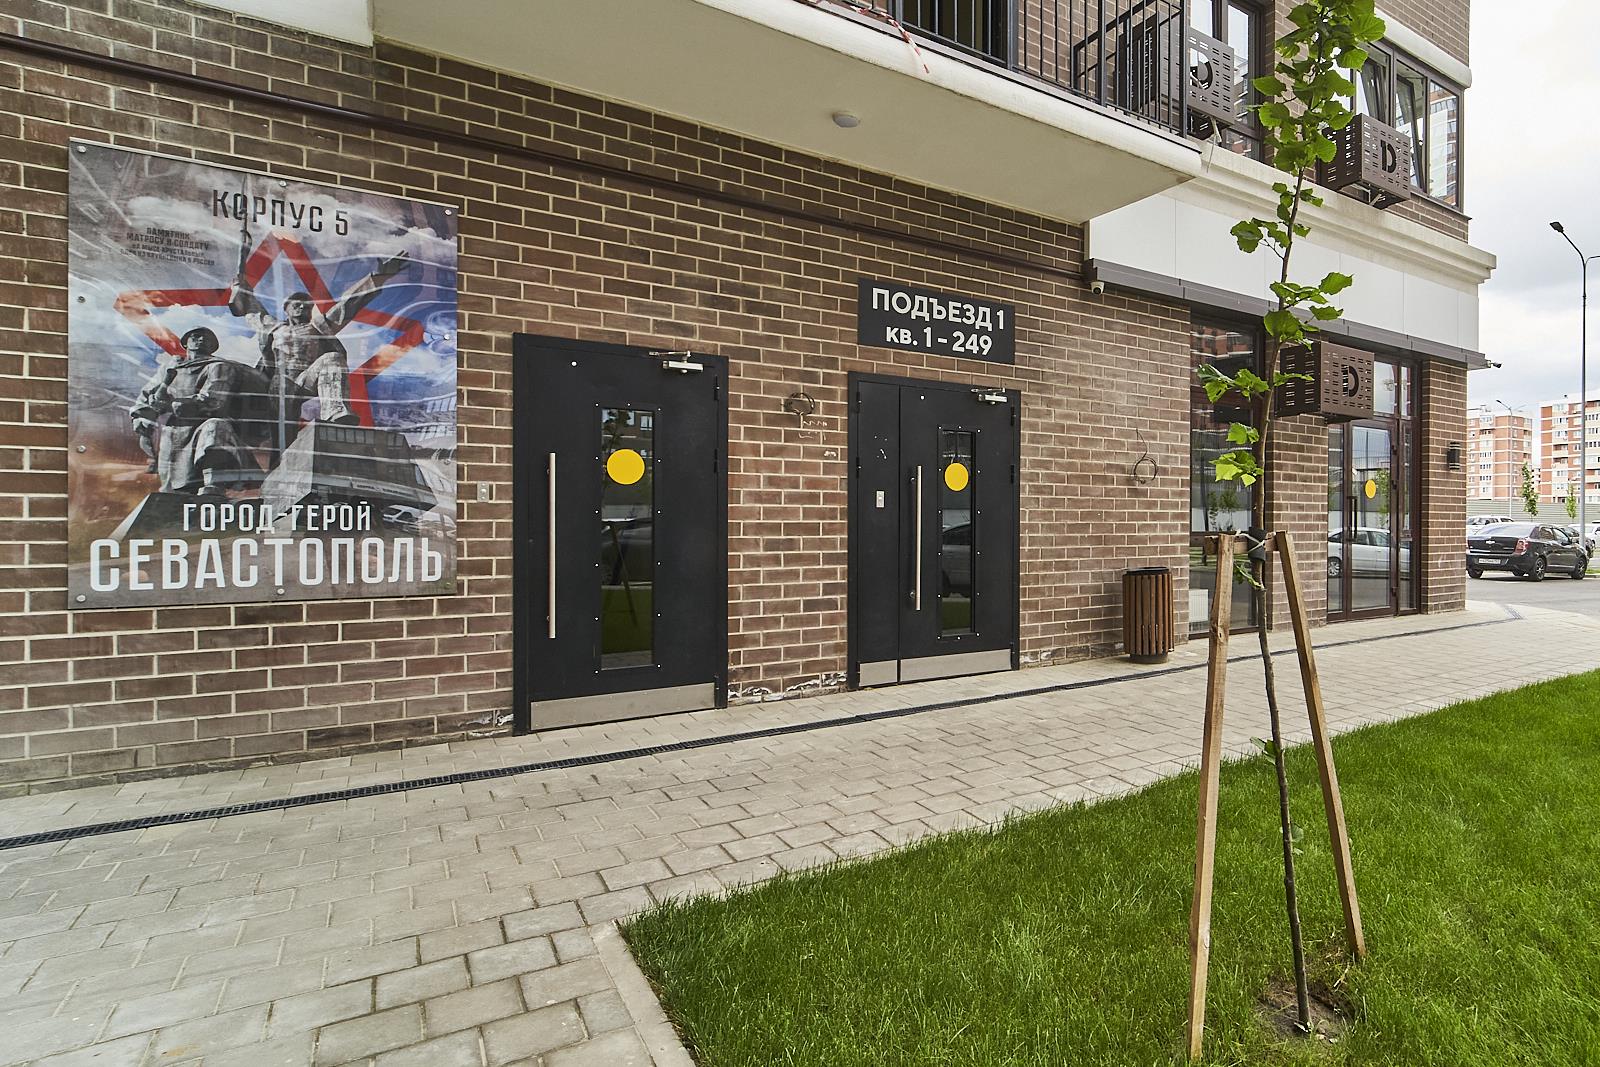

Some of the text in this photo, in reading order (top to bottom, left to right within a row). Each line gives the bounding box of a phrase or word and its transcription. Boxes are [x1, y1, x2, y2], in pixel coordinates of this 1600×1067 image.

[212, 189, 349, 236] КОРПУС 5
[126, 232, 164, 245] МАТРОСУ
[174, 239, 209, 251] СОЛДАТУ
[872, 287, 1004, 332] ПОДЪЕЗД 1
[952, 330, 993, 356] 249
[183, 500, 372, 534] ГОРОД-ГЕРОЙ
[89, 537, 443, 592] СЕВАСТОПОЛЬ
